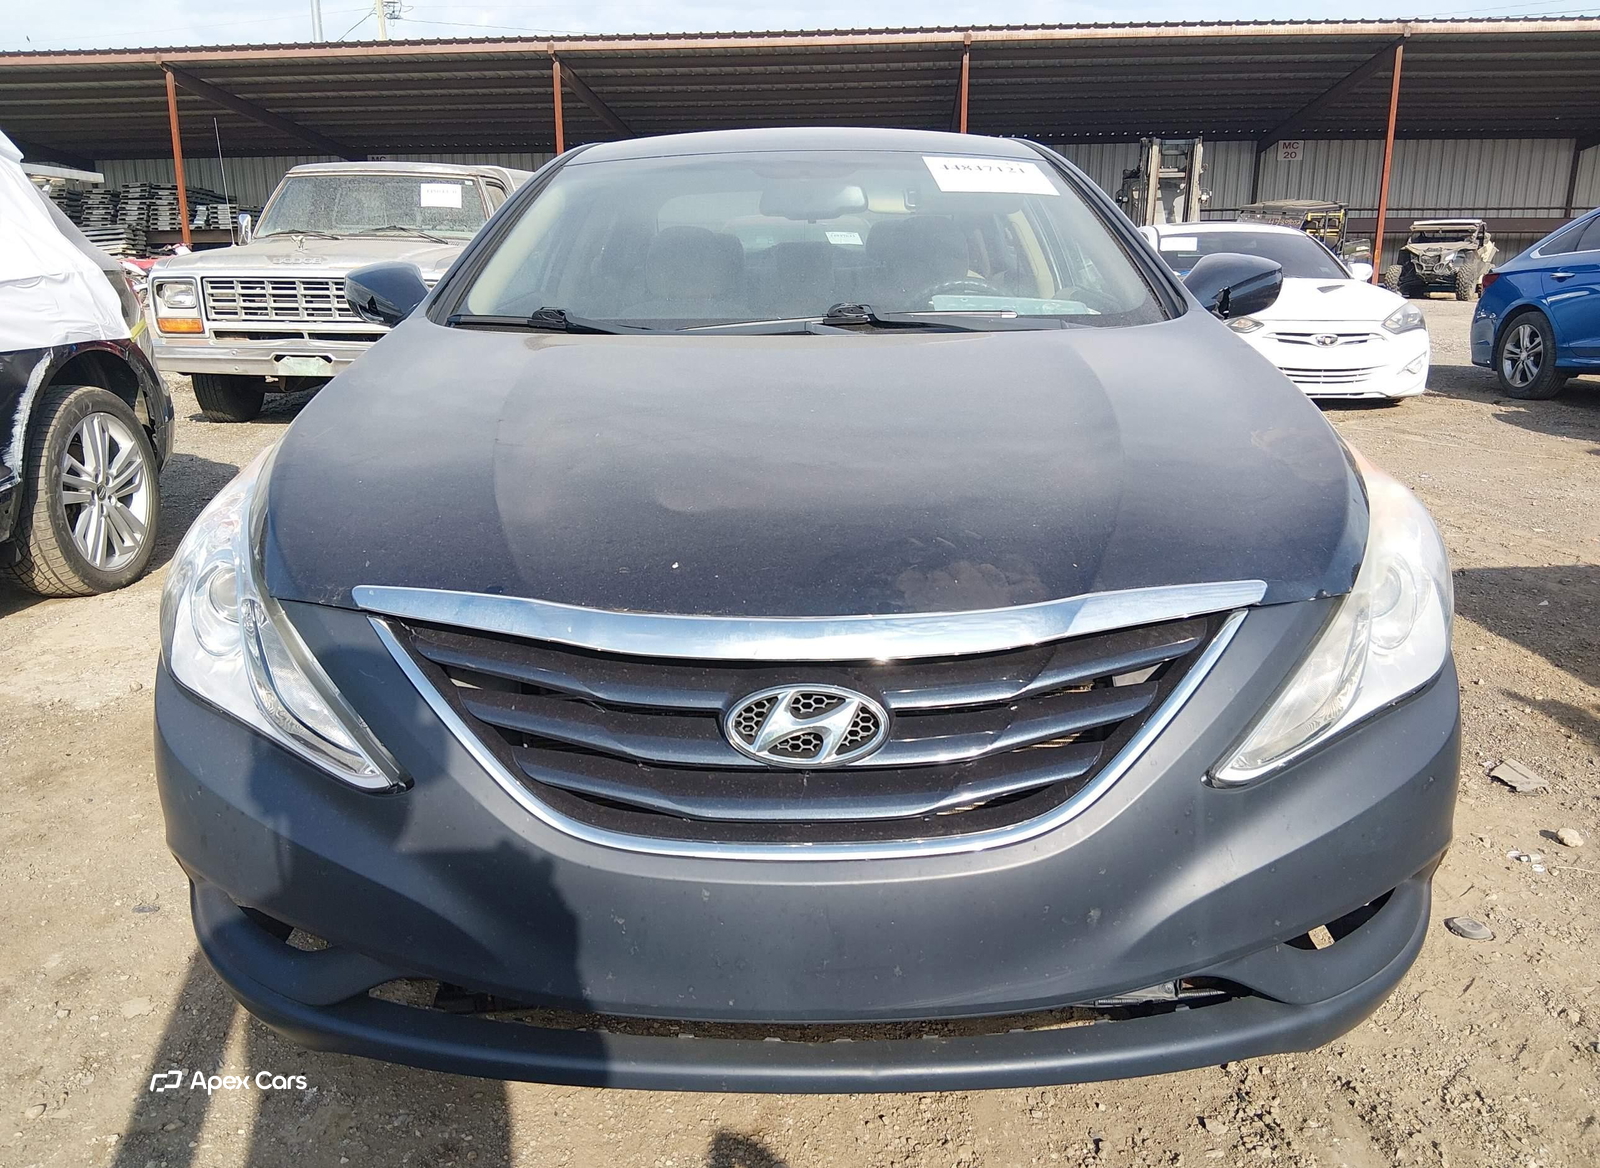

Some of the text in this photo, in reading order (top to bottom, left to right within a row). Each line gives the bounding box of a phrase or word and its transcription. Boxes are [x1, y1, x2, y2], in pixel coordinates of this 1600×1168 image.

[1282, 142, 1299, 150] MC
[1283, 151, 1297, 159] 20
[272, 257, 322, 265] DODGE
